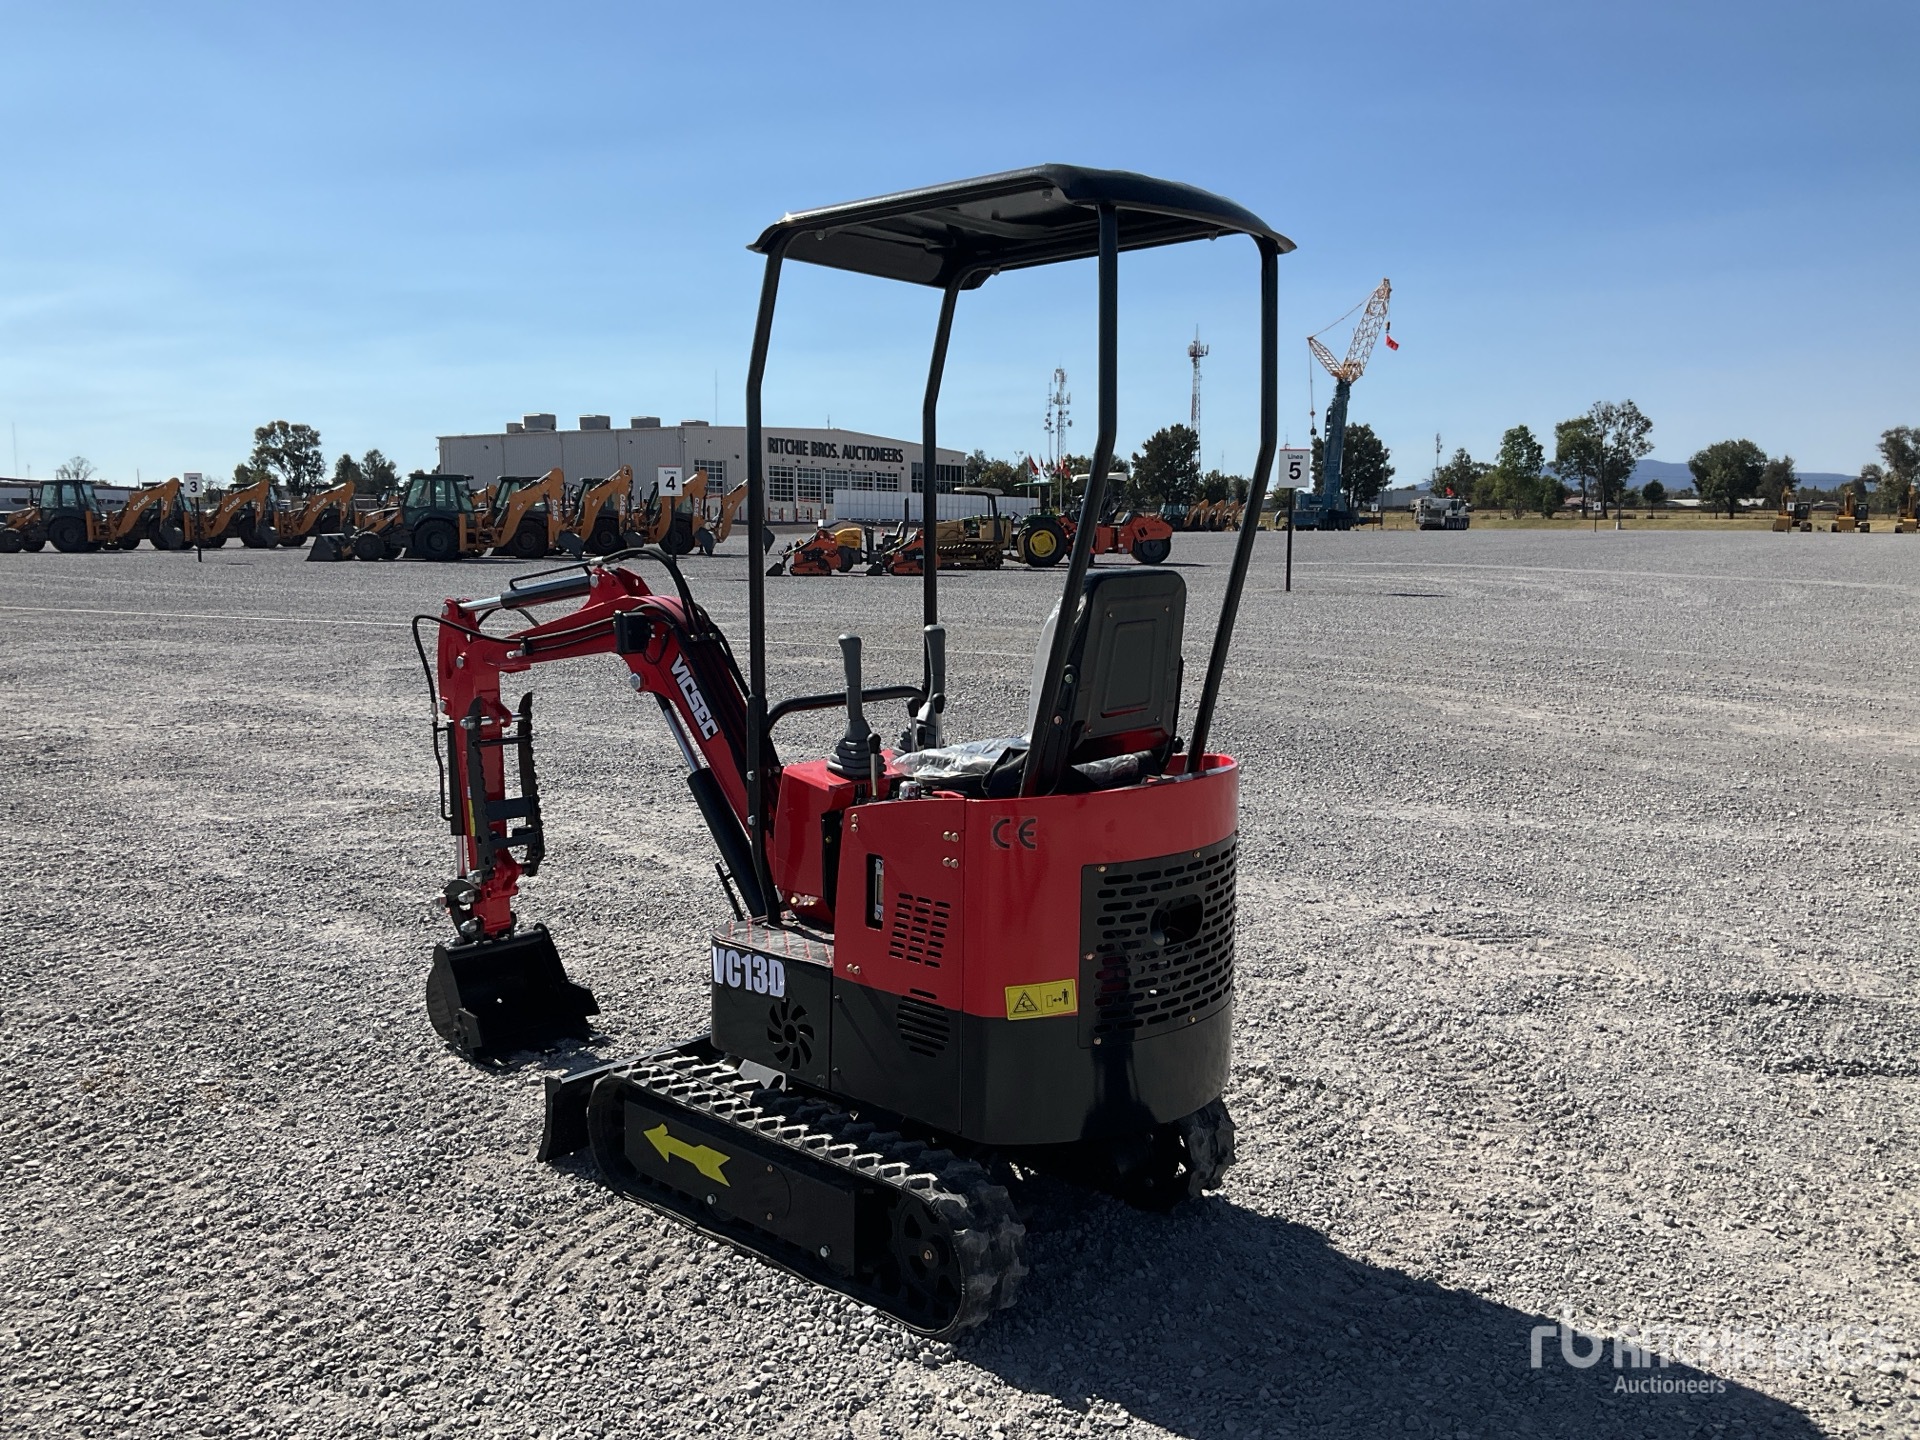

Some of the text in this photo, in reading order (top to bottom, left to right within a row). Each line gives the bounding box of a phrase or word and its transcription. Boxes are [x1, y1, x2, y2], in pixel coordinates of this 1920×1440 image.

[767, 437, 904, 463] RITCHIE BROS. AUCTIONEERS
[1288, 461, 1302, 480] 5
[189, 481, 198, 493] 3
[665, 476, 677, 490] 4
[132, 495, 150, 511] CASE
[224, 497, 241, 512] CASE
[670, 652, 719, 741] VICSEC
[992, 818, 1037, 850] CE
[711, 945, 786, 998] VC13D
